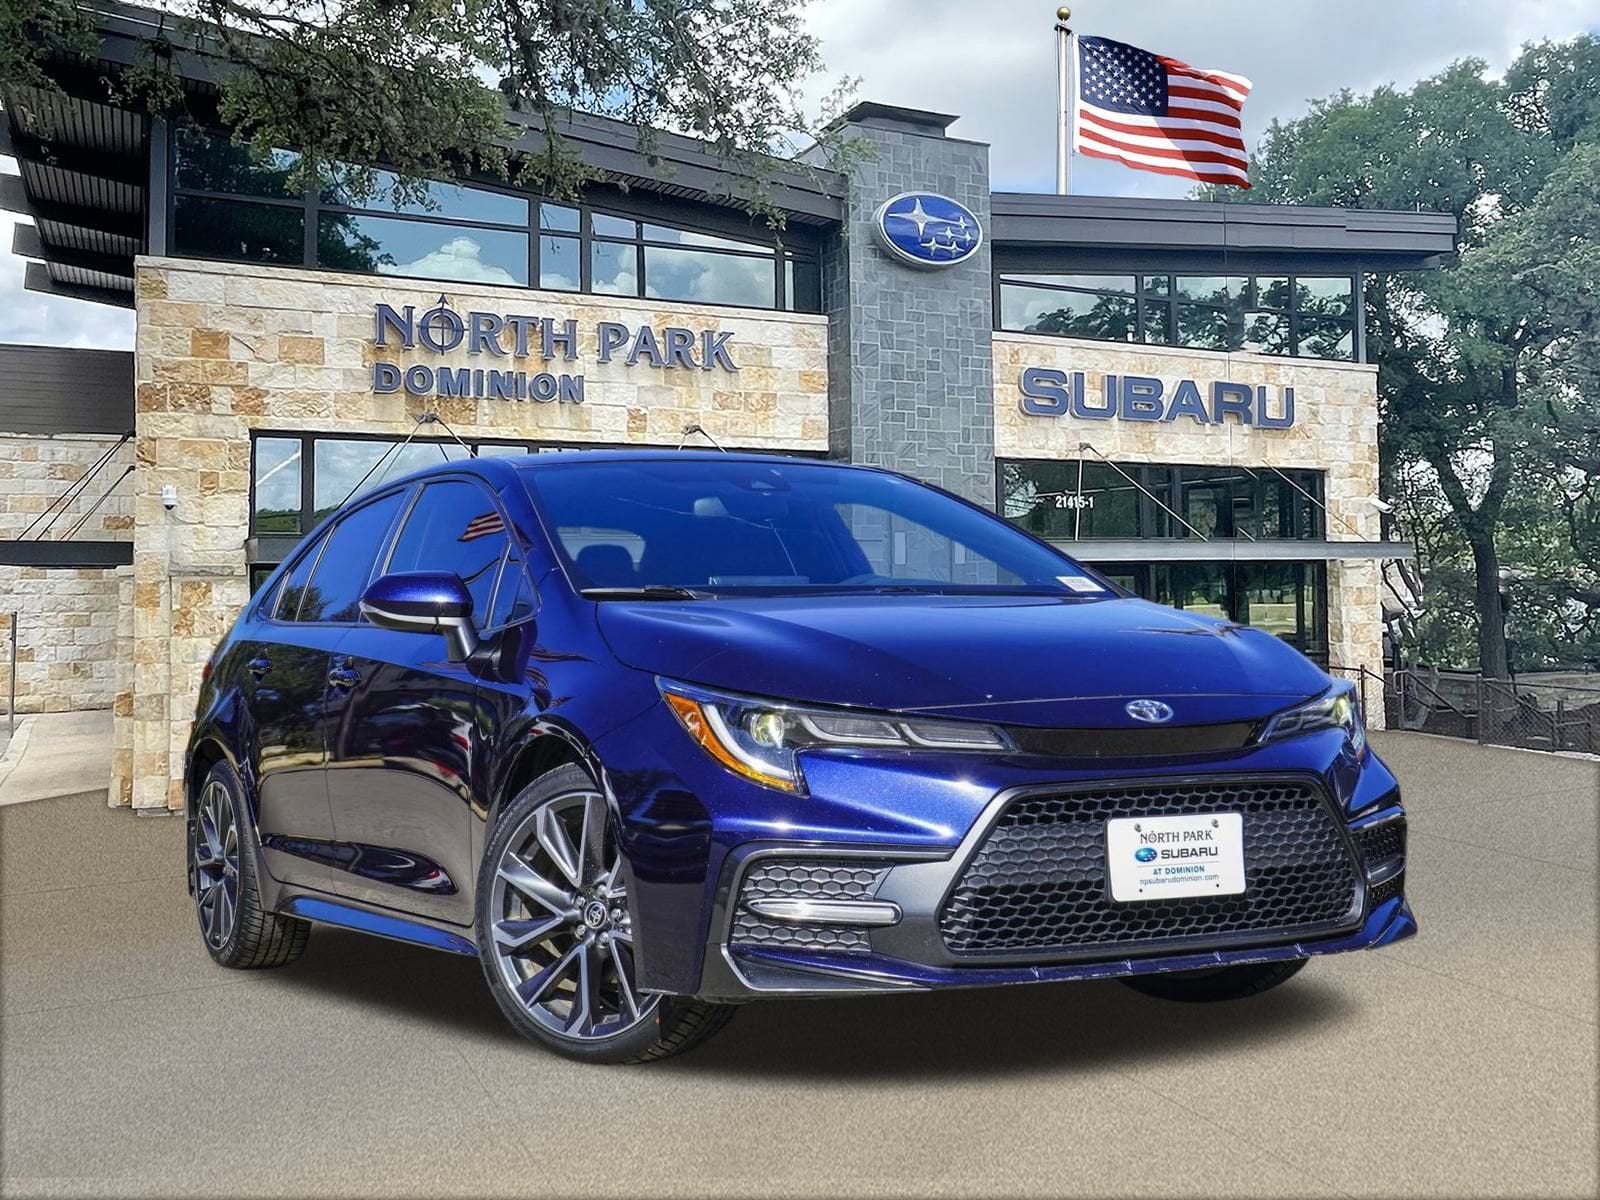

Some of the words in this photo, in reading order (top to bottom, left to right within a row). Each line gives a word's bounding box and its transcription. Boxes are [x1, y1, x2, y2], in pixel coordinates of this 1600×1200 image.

[375, 293, 578, 361] NORTH
[598, 321, 740, 373] PARK
[373, 362, 584, 404] DOMINION
[1019, 367, 1294, 429] SUBARU
[1055, 495, 1094, 509] 21415-1
[1140, 831, 1180, 844] NORTH
[1183, 830, 1213, 841] PARK
[1161, 846, 1218, 859] SUBARU
[1153, 868, 1162, 876] AT
[1165, 866, 1205, 875] DOMINION
